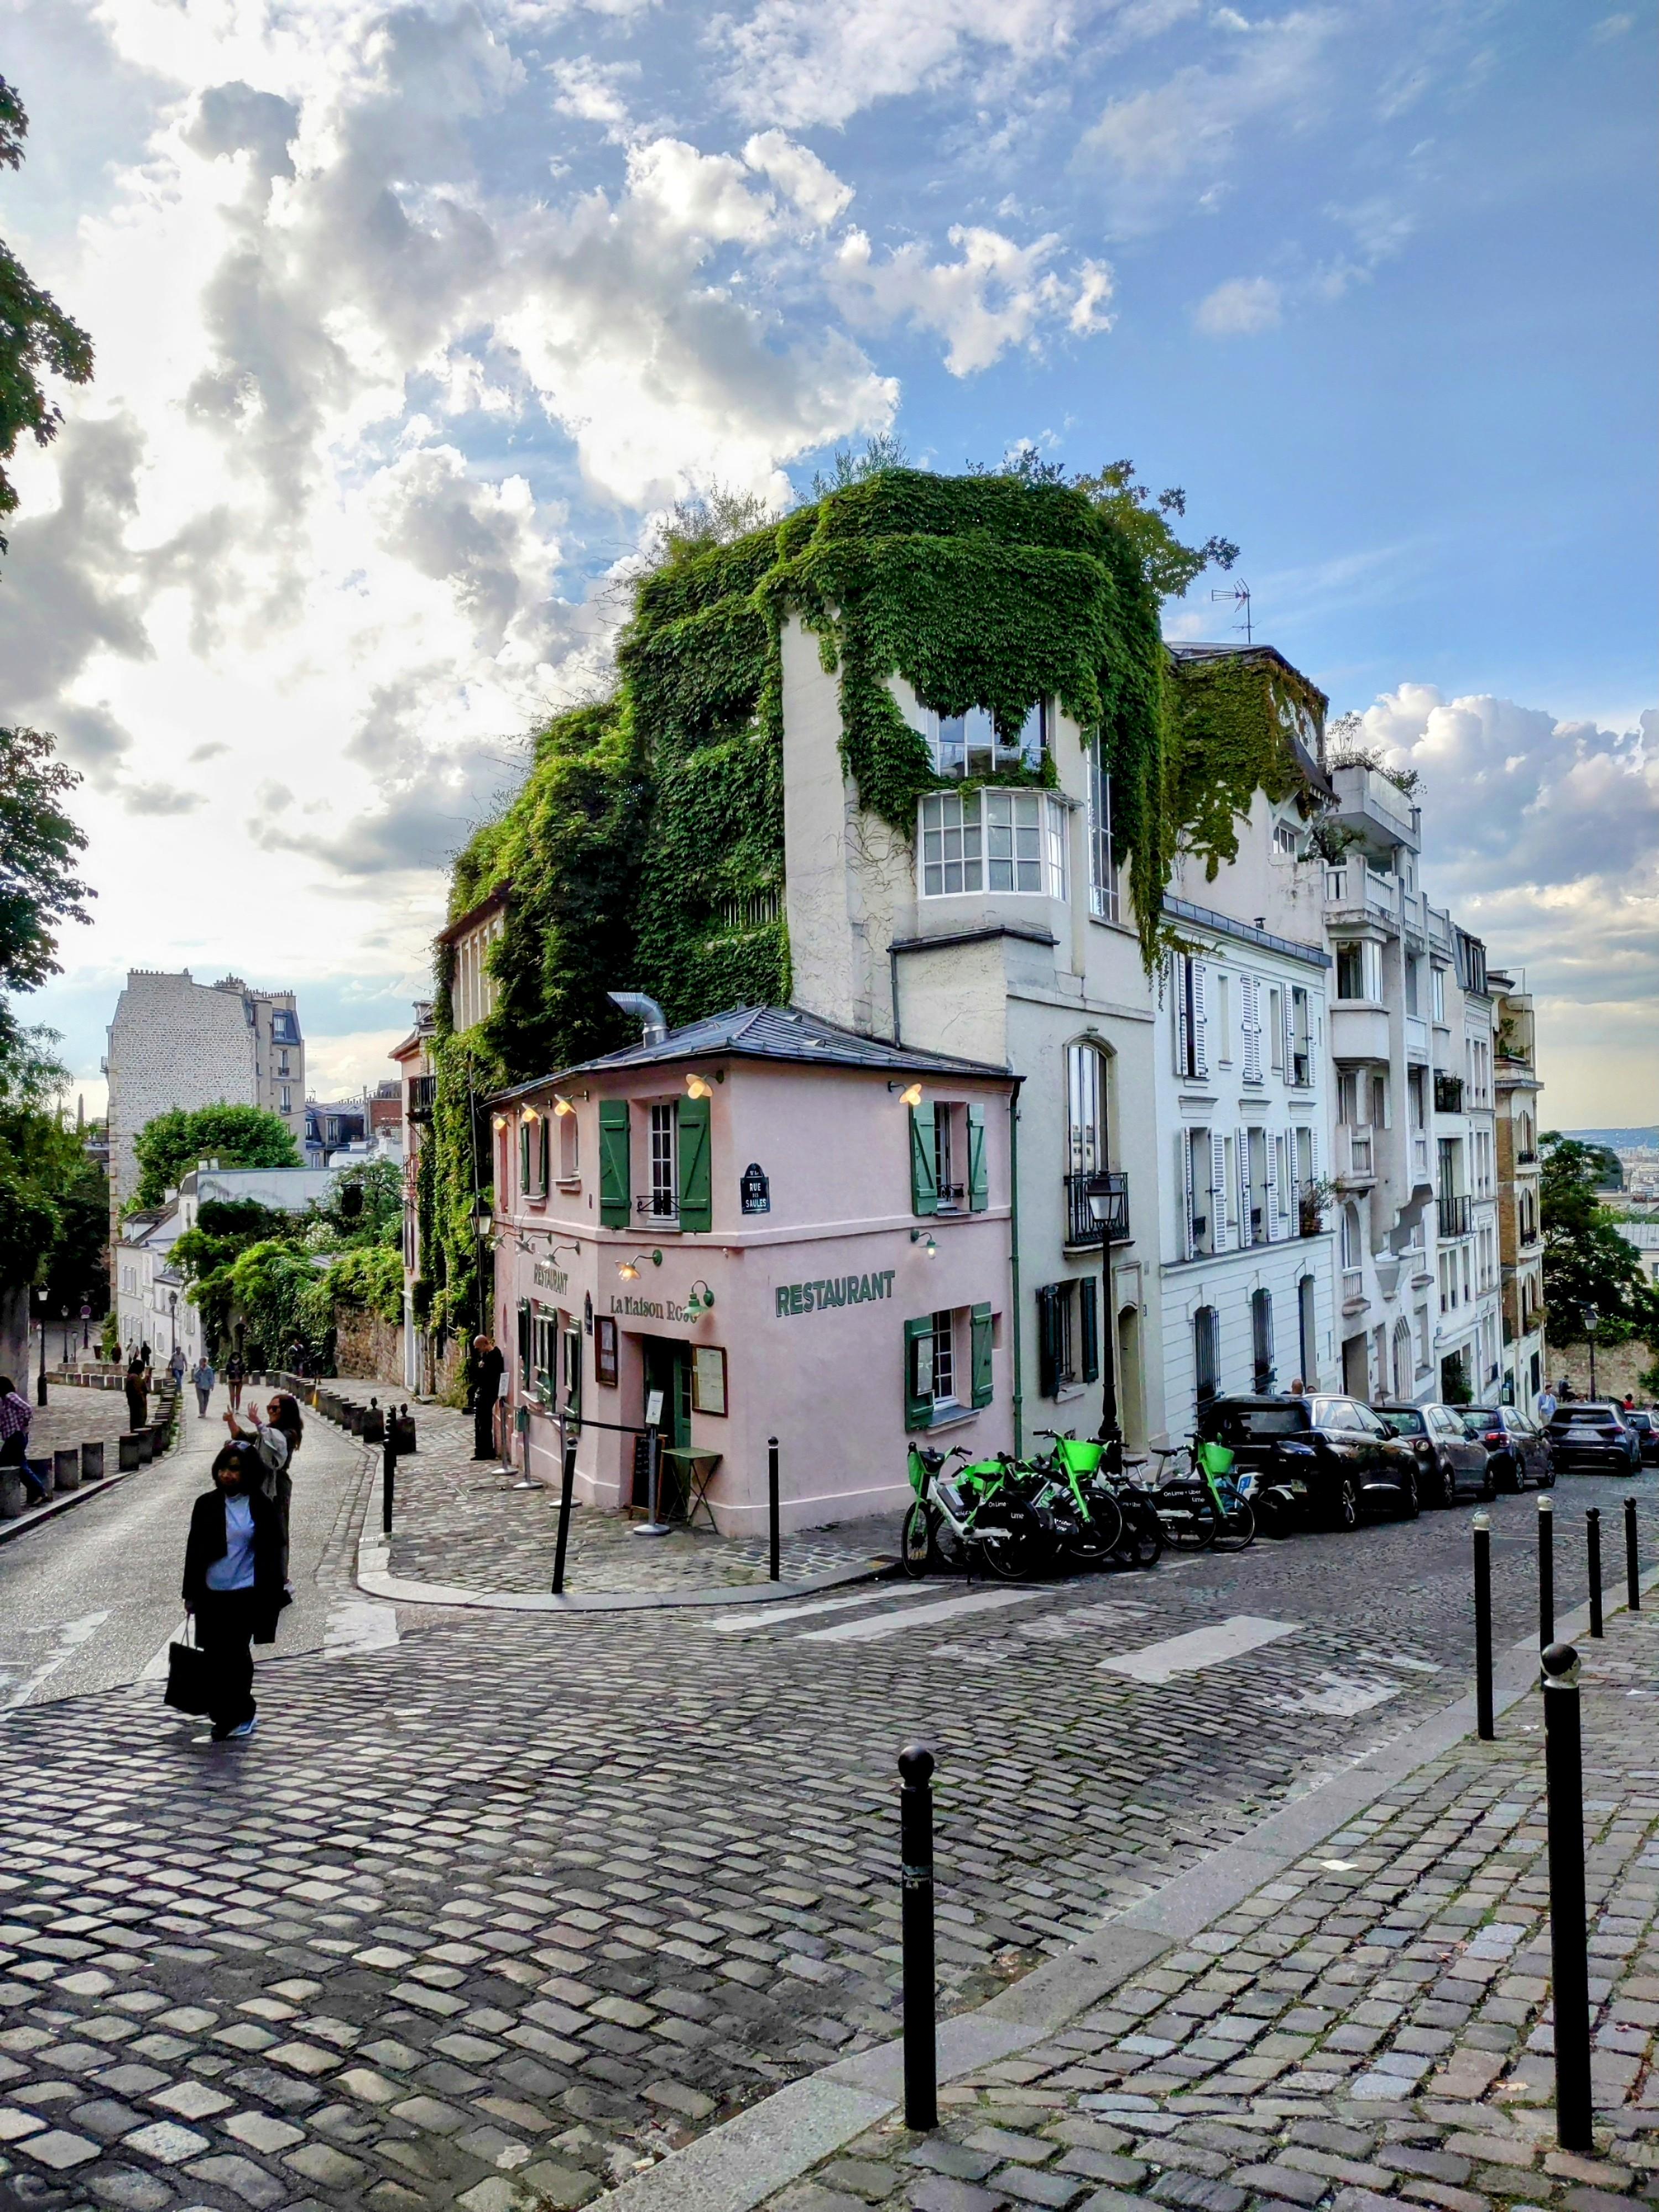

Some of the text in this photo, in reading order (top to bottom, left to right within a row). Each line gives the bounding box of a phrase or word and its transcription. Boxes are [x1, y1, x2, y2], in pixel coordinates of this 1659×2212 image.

[749, 1183, 761, 1192] RUE
[745, 1198, 766, 1208] SAULES
[775, 1270, 895, 1318] RESTAURANT
[610, 1295, 623, 1314] La
[624, 1296, 664, 1319] Maison
[1039, 1489, 1056, 1509] ime
